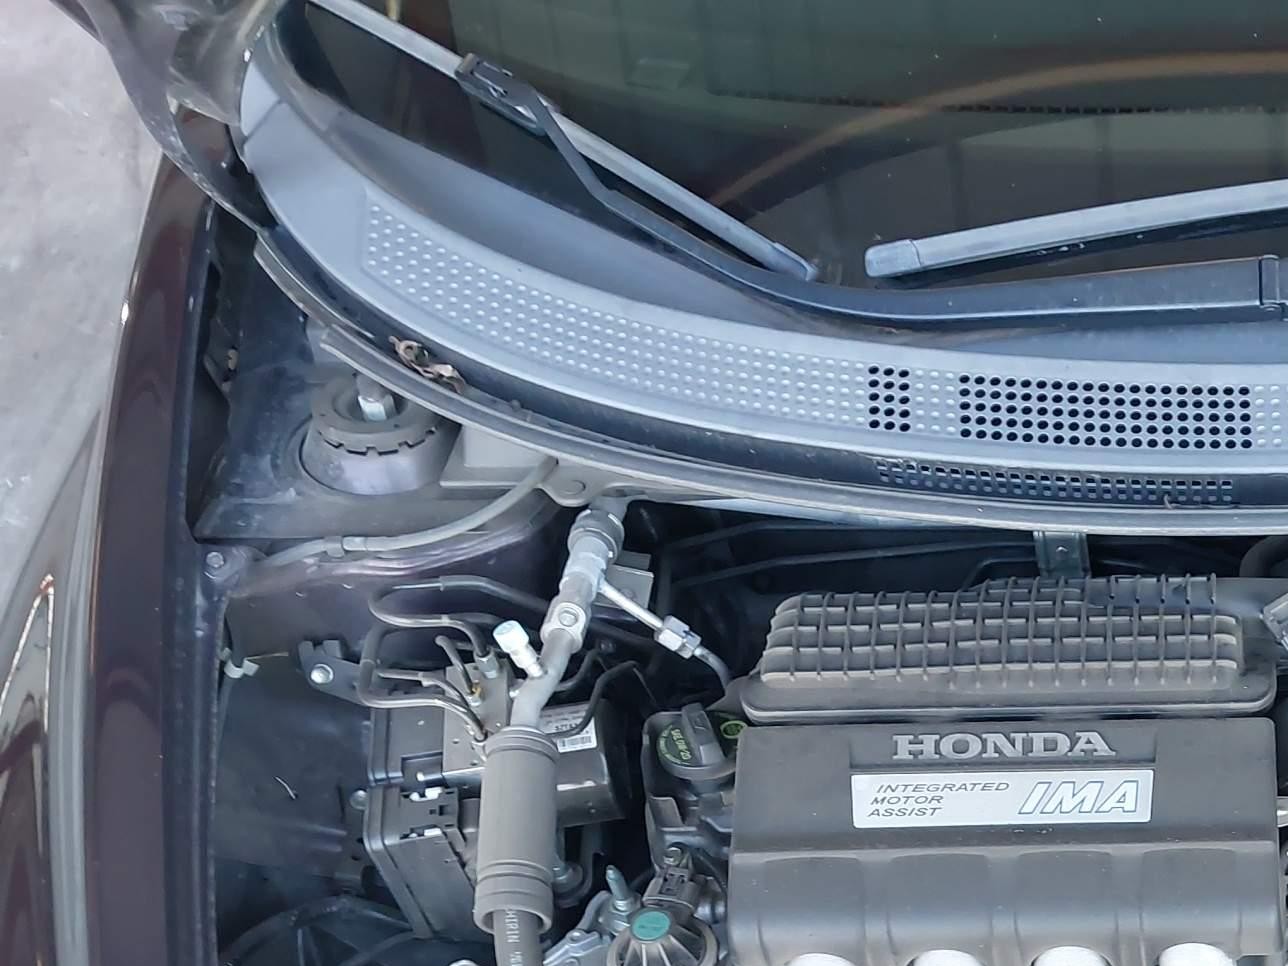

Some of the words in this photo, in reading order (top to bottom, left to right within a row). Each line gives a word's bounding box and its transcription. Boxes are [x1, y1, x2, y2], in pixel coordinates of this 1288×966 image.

[892, 731, 1117, 760] HONDA
[876, 782, 1010, 794] INTEGRATED
[870, 795, 944, 805] MOTOR
[1017, 779, 1140, 815] IMA
[867, 807, 942, 817] ASSIST
